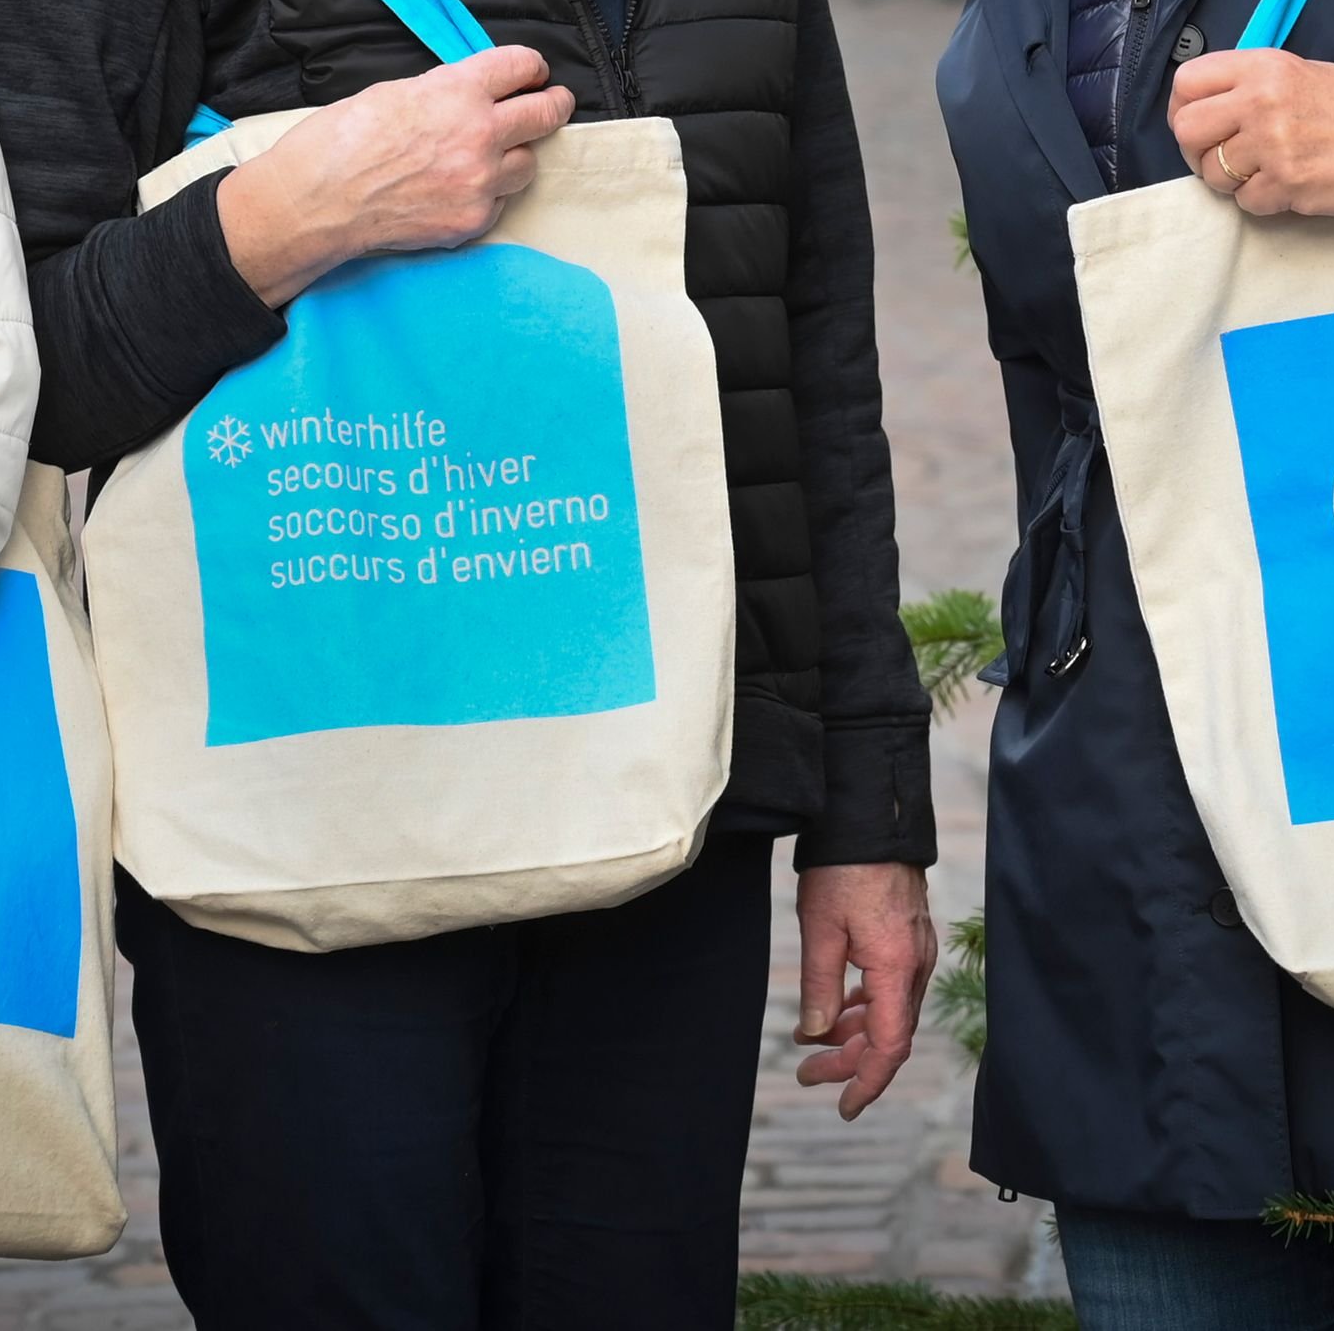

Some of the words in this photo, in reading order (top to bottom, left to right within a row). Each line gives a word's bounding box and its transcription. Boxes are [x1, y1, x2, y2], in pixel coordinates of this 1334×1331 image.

[261, 407, 446, 451] winterhilfe
[268, 460, 396, 496] secours
[409, 452, 536, 494] d'hiver
[268, 509, 421, 542] soccorso
[435, 493, 609, 541] d'inverno
[271, 553, 405, 589] succurs
[417, 538, 591, 585] d'enviern
